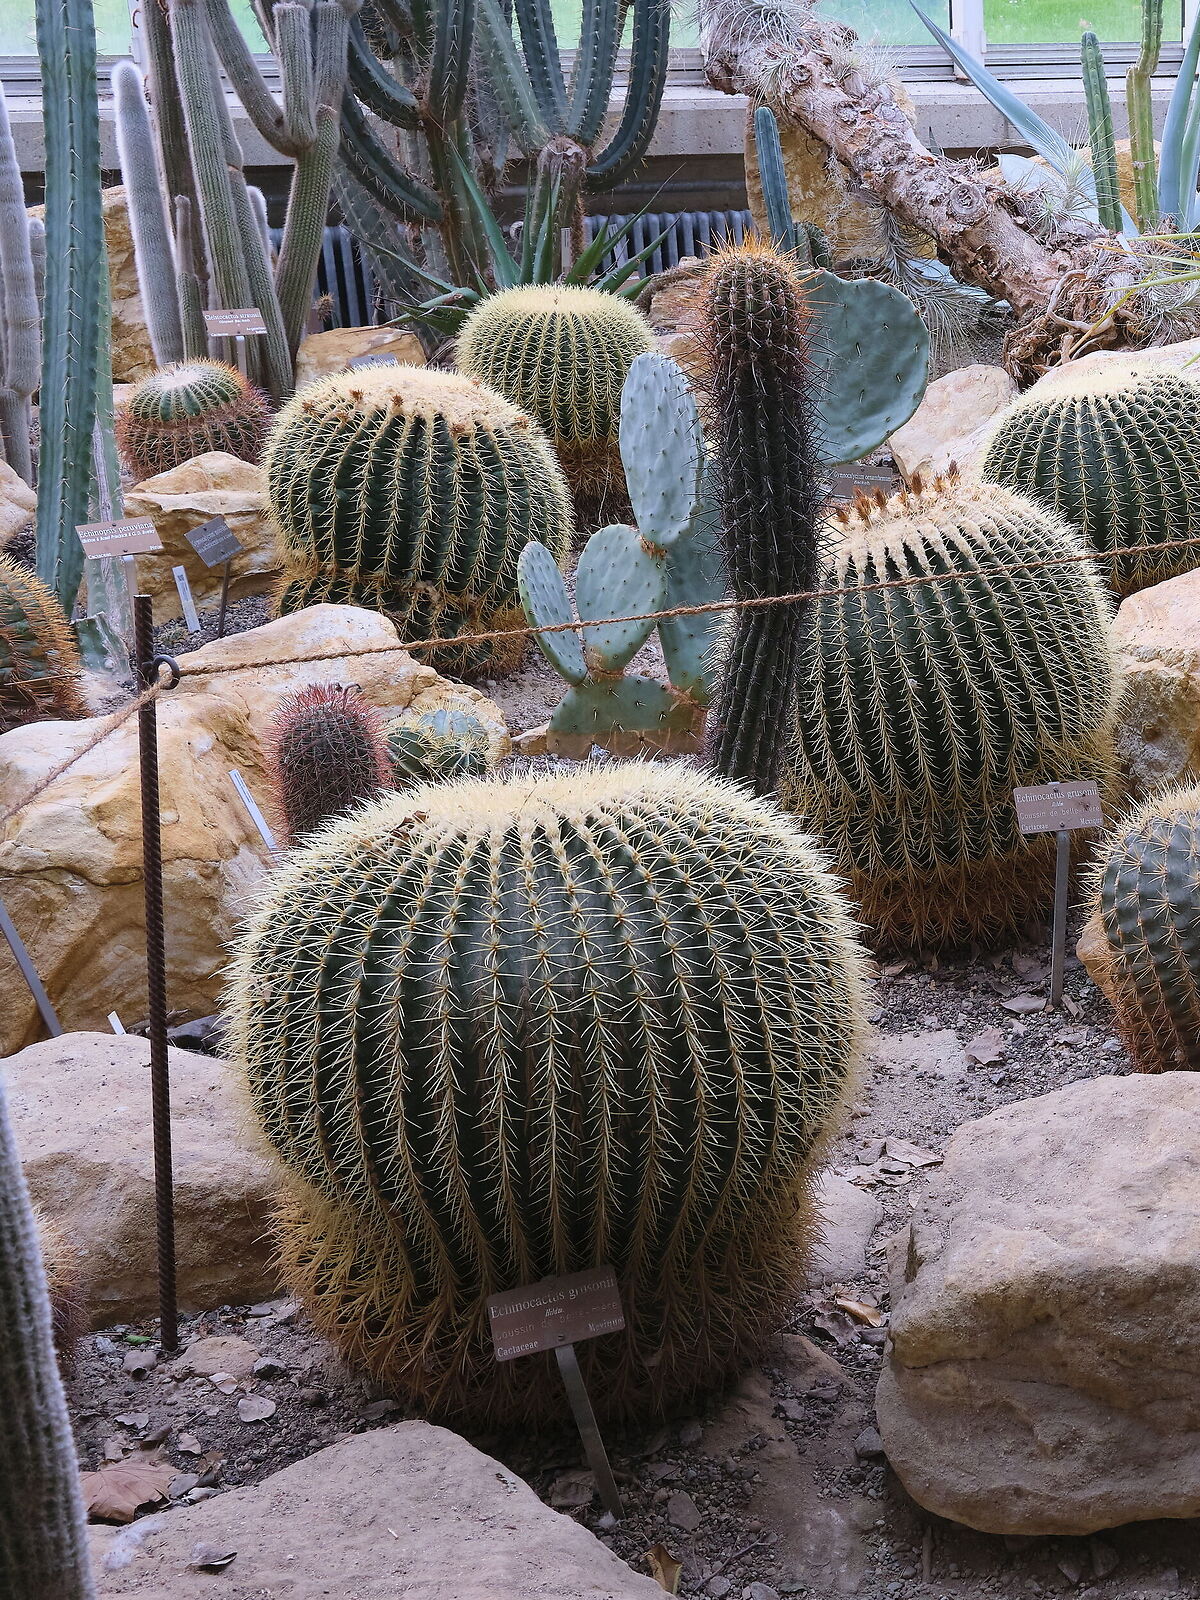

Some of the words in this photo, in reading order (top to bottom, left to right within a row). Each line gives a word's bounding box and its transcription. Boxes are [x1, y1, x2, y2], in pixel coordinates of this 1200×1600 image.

[1015, 791, 1066, 803] Echinocactus
[1066, 786, 1098, 800] grusonii
[490, 1291, 565, 1319] Echinocactus
[497, 1340, 539, 1358] Cactaceae
